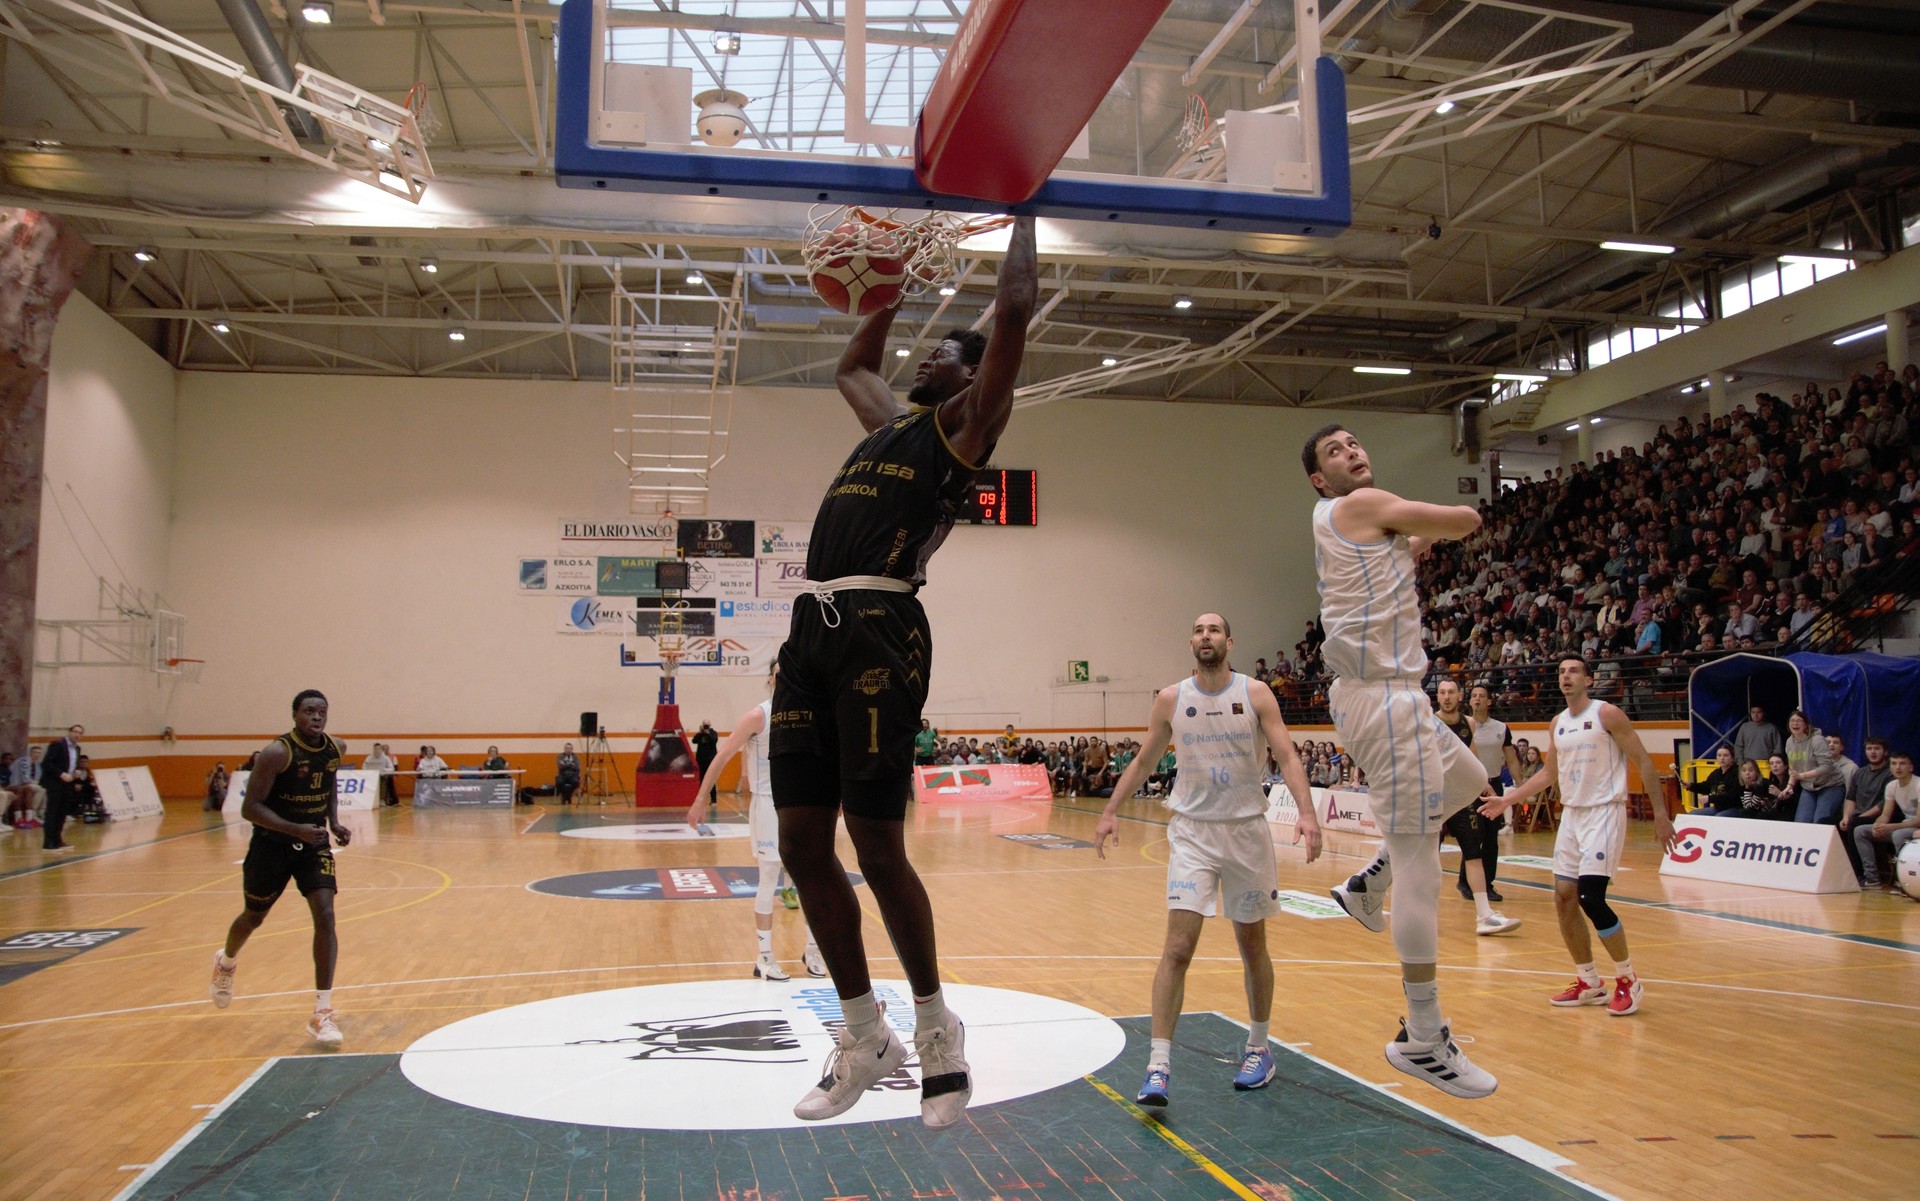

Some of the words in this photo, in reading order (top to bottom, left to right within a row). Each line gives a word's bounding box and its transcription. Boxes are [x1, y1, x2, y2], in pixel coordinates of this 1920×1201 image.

[876, 462, 915, 480] ISB
[979, 493, 996, 505] 09
[985, 508, 992, 518] 0
[564, 524, 581, 537] EL
[583, 525, 629, 538] DIARIO
[631, 525, 673, 538] VASCO
[867, 707, 879, 753] 1
[1196, 731, 1251, 743] Naturklima
[1210, 767, 1230, 785] 16
[1326, 795, 1363, 823] AMET
[1710, 839, 1820, 867] sammic
